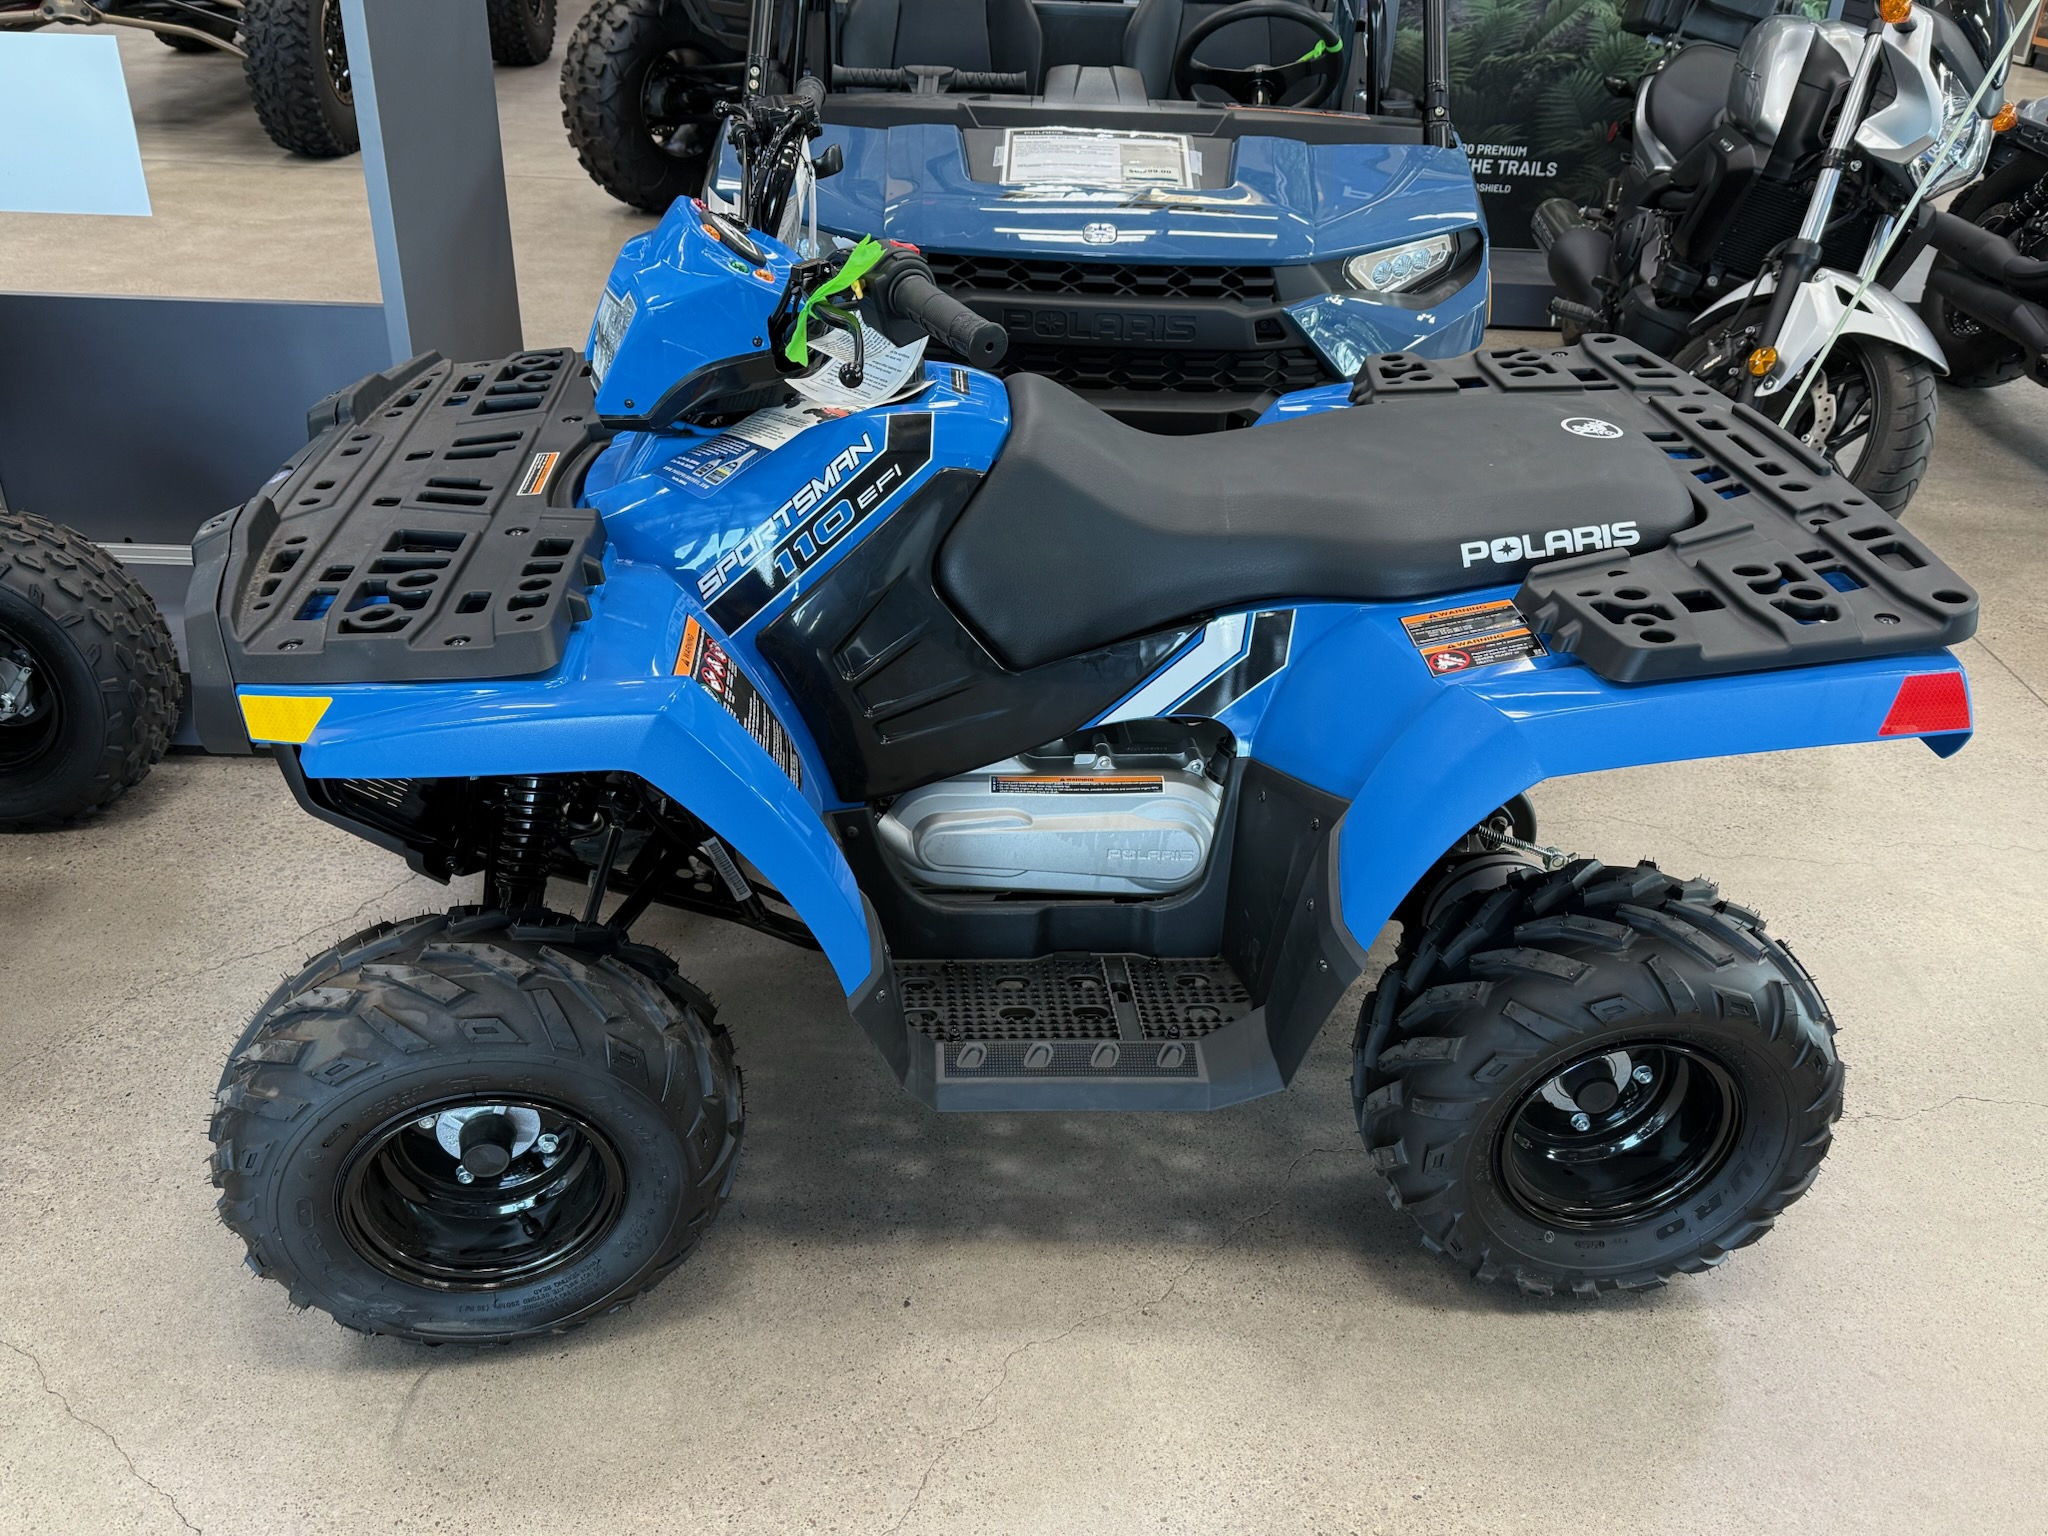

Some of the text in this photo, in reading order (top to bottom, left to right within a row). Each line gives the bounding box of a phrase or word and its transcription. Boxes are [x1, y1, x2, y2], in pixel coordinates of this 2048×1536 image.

[1477, 144, 1528, 157] PREMIUM
[1468, 158, 1558, 177] HE TRAILS
[1476, 183, 1512, 194] SHIELD
[1002, 309, 1197, 342] POLARIS
[697, 432, 875, 601] SPORTSMAN
[773, 463, 903, 578] 110 EFI
[1460, 520, 1641, 568] POLARIS
[1438, 604, 1488, 617] WARNING
[683, 633, 695, 659] WARNING
[1457, 633, 1505, 647] WARNING
[1107, 848, 1194, 861] POLARIS
